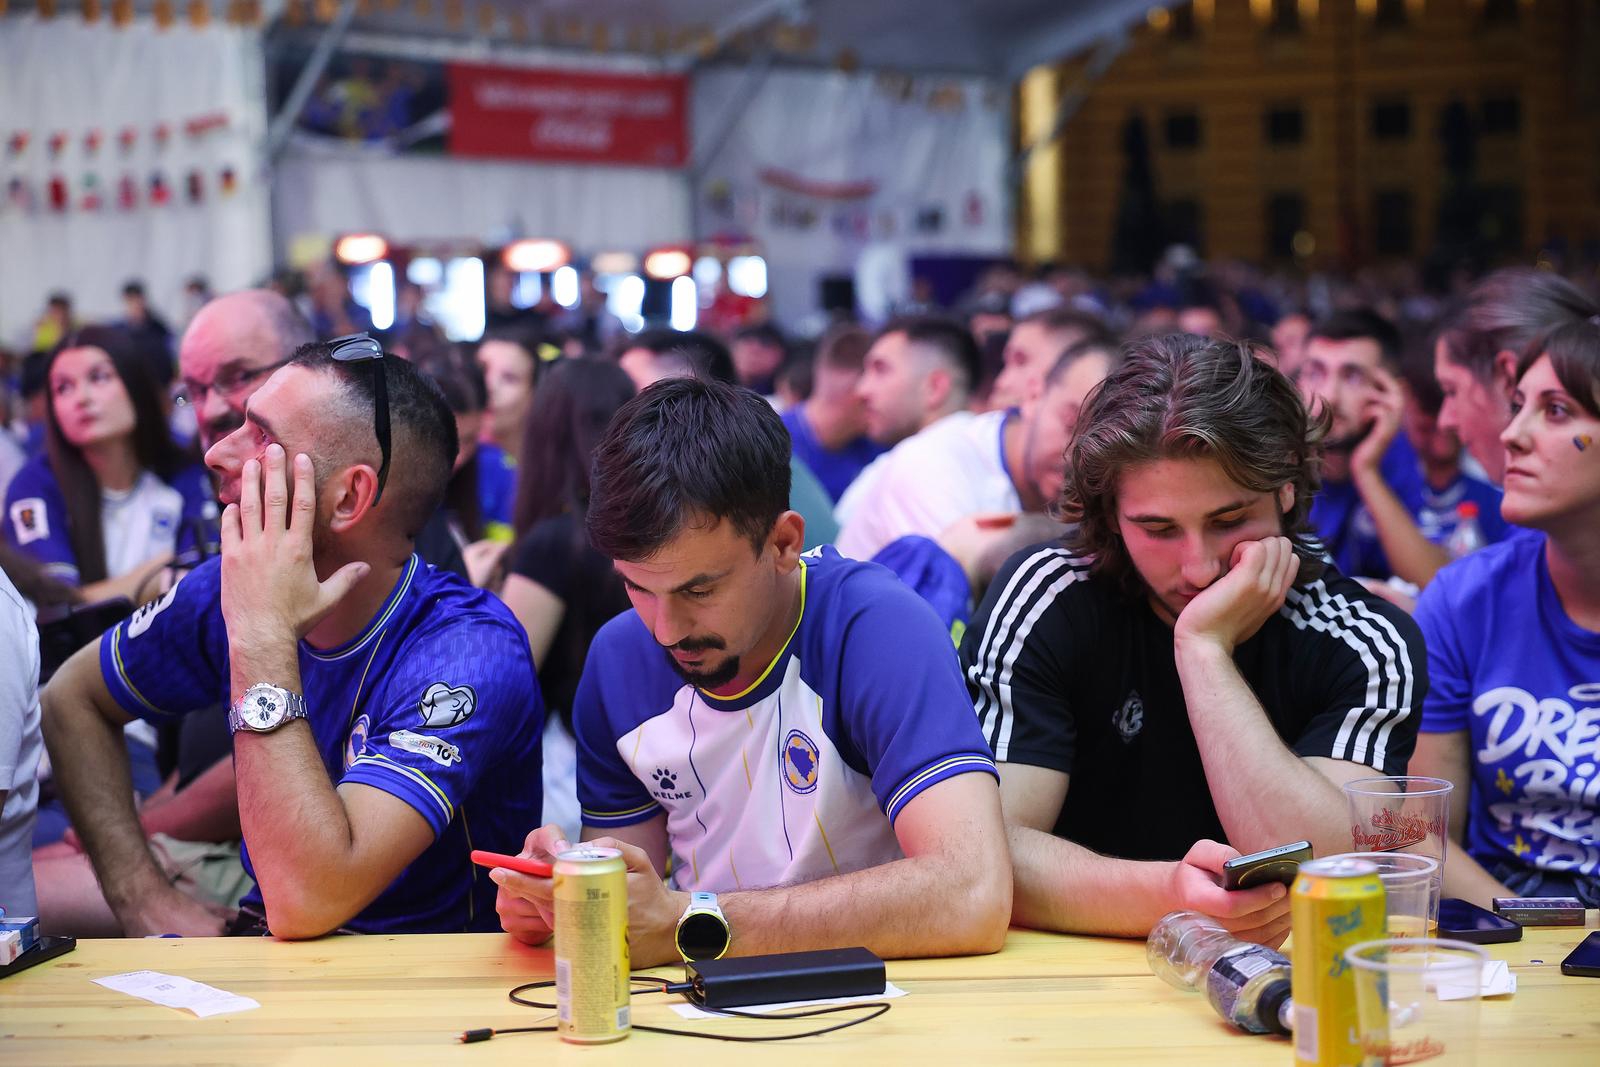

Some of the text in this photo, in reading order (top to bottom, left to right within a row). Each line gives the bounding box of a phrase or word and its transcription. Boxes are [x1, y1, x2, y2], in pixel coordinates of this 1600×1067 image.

[1473, 686, 1600, 768] DRE
[436, 744, 452, 761] 10
[653, 791, 693, 800] KELME
